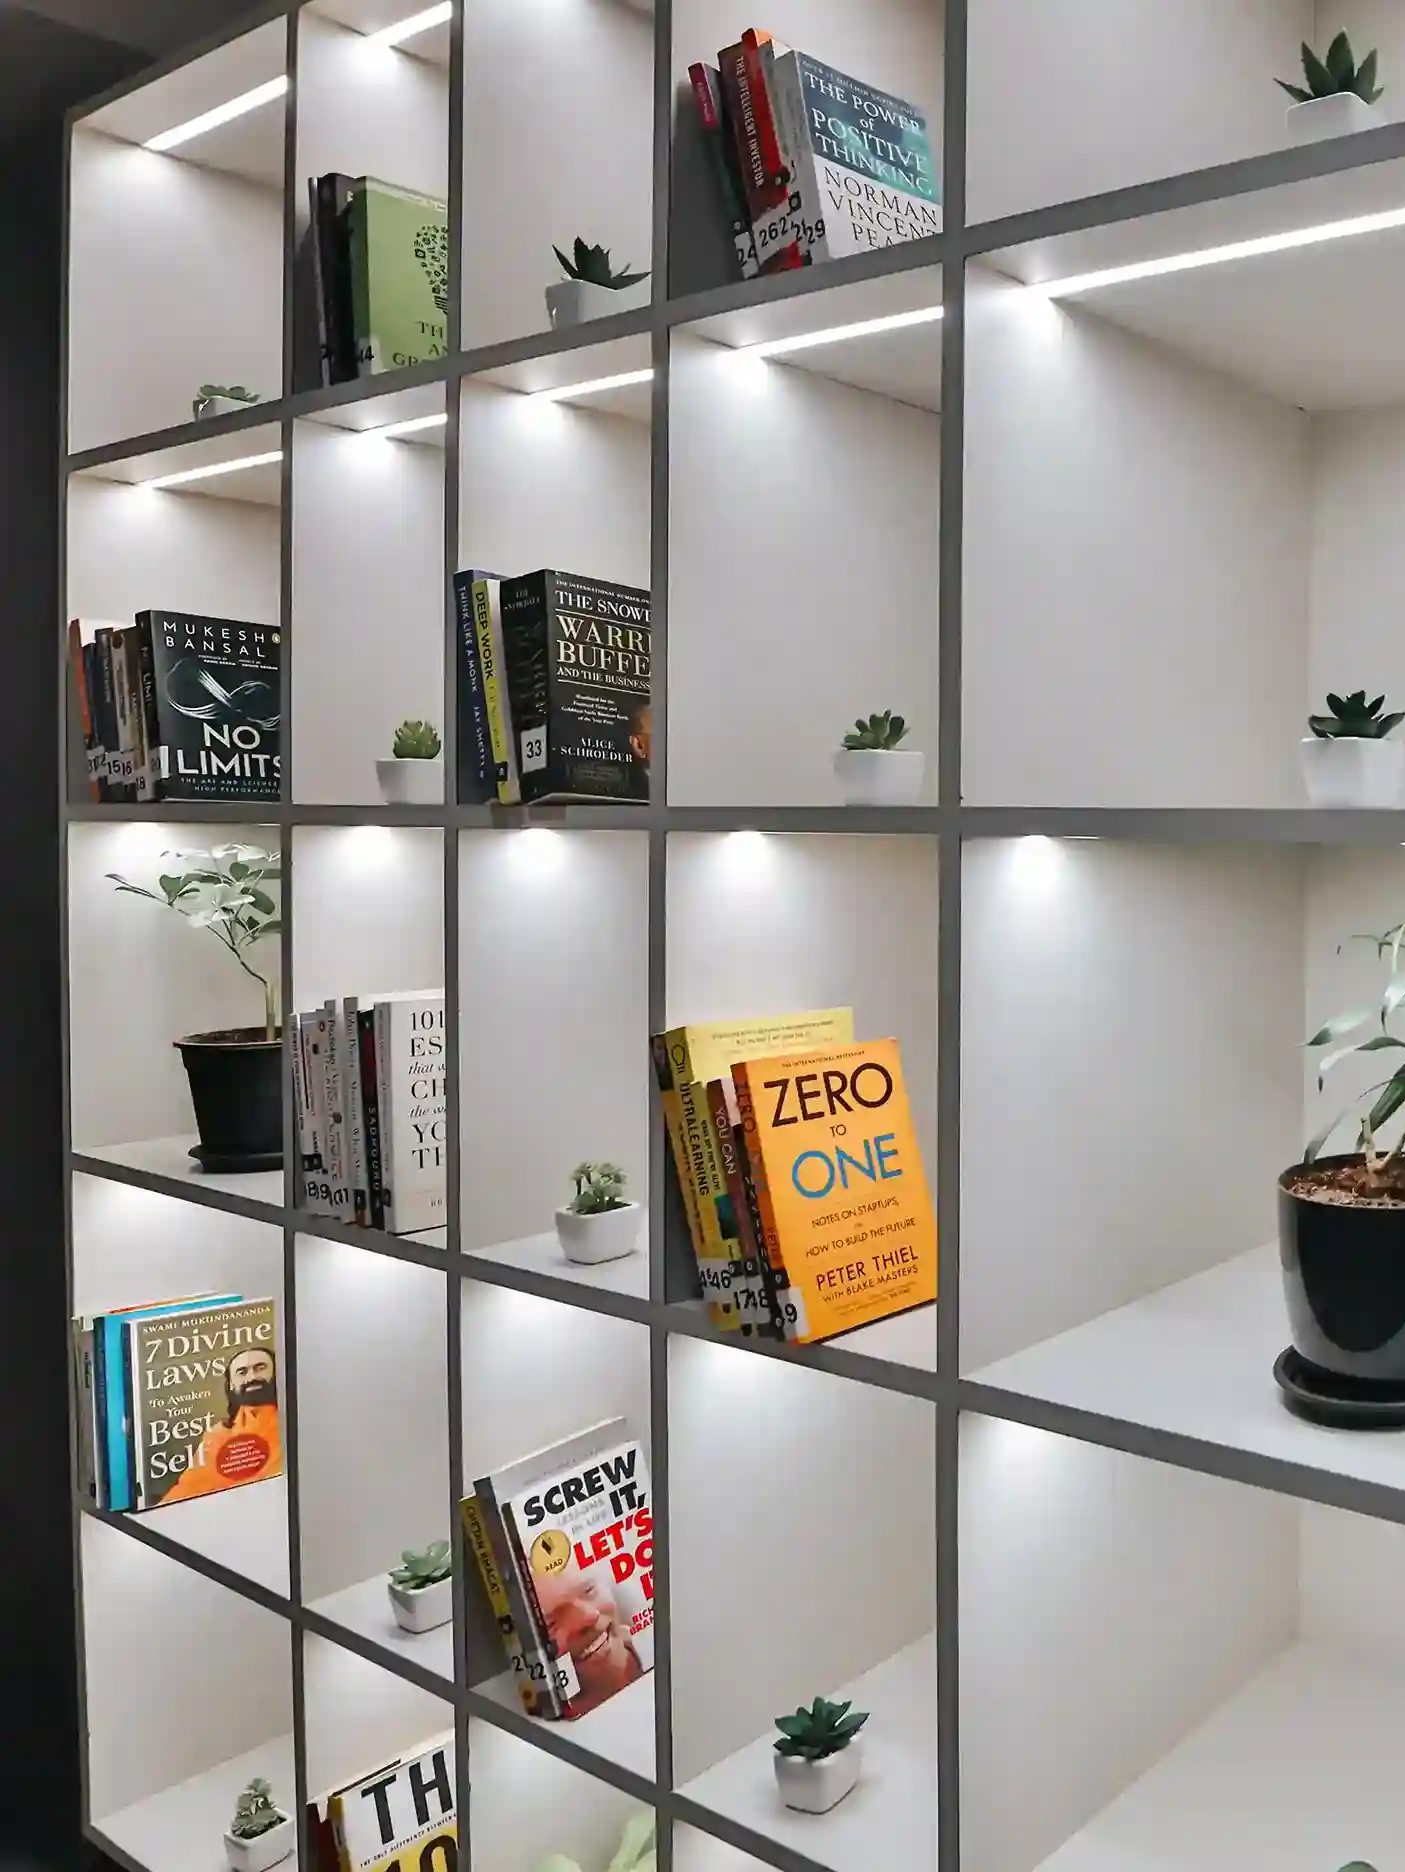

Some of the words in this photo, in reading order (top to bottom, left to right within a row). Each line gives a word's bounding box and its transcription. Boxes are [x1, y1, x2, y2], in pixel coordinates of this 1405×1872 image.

[804, 72, 848, 104] THE
[852, 94, 924, 137] POWER
[811, 107, 930, 175] POSITIVE
[815, 132, 933, 196] THINKING
[824, 166, 937, 227] NORMAN
[457, 585, 469, 619] THINK
[475, 592, 487, 630] DEEP
[555, 590, 593, 611] THE
[163, 621, 265, 643] MUKESH
[165, 635, 267, 658] BANSAL
[463, 622, 473, 646] LIKE
[556, 614, 652, 654] WARR
[480, 632, 495, 681] WORK
[556, 639, 652, 677] BUFFE
[467, 660, 478, 693] MONK
[556, 666, 580, 678] AND
[581, 670, 602, 681] THE
[605, 674, 651, 690] BUSINESS
[202, 721, 261, 750] NO
[526, 739, 543, 759] 33
[581, 737, 616, 750] ALICE
[176, 748, 281, 778] LIMITS
[560, 745, 633, 763] SCHROEDER
[409, 1009, 444, 1031] 101
[410, 1035, 443, 1057] ES
[408, 1061, 434, 1075] that
[411, 1078, 447, 1100] CH
[763, 1062, 893, 1128] ZERO
[409, 1104, 430, 1118] the
[715, 1106, 728, 1139] YOU
[679, 1082, 710, 1197] ULTRALEARNING
[829, 1123, 847, 1137] TO
[721, 1142, 737, 1175] CAN
[792, 1132, 904, 1199] ONE
[812, 1213, 840, 1228] NOTES
[841, 1208, 857, 1220] ON
[806, 1243, 830, 1258] HOW
[832, 1239, 844, 1250] TO
[846, 1231, 868, 1246] BUILD
[869, 1226, 885, 1239] THE
[885, 1217, 917, 1233] FUTURE
[816, 1261, 866, 1292] PETER
[871, 1245, 919, 1272] THIEL
[822, 1290, 844, 1303] WITH
[846, 1278, 875, 1296] BLAKE
[876, 1264, 919, 1284] MASTERS
[143, 1322, 177, 1334] SWAMI
[145, 1339, 163, 1364] 7
[167, 1322, 272, 1358] Divine
[145, 1357, 226, 1391] Laws
[149, 1398, 165, 1408] To
[167, 1391, 212, 1406] Awaken
[165, 1405, 194, 1418] Your
[148, 1411, 215, 1447] Best
[150, 1440, 209, 1479] Self
[523, 1448, 637, 1527] SCREW
[608, 1481, 647, 1518] IT,
[573, 1507, 655, 1571] LET'S
[609, 1538, 655, 1584] DO
[361, 1749, 454, 1845] TH
